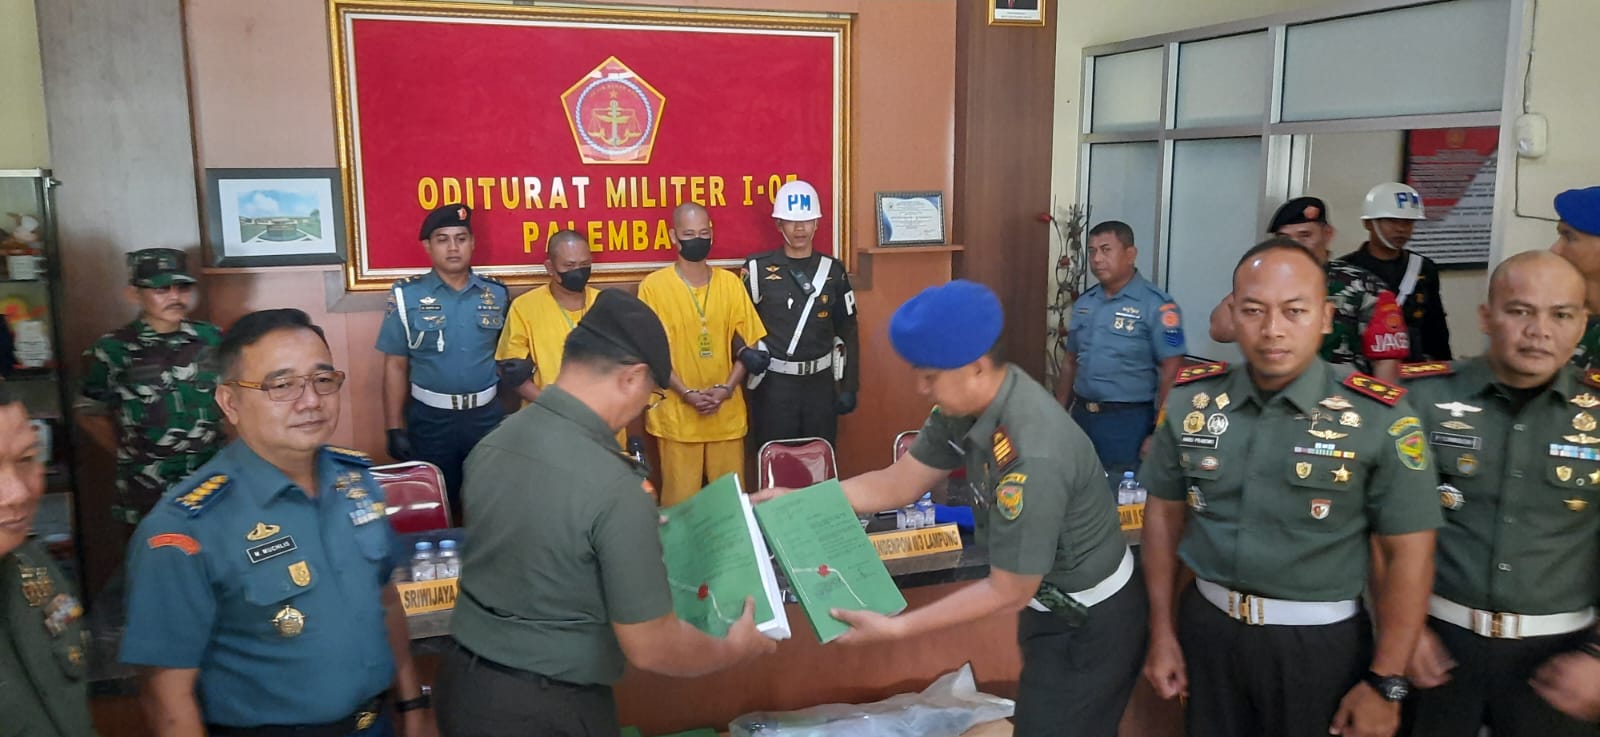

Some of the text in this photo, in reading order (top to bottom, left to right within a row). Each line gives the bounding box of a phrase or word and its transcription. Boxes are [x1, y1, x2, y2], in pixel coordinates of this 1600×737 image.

[417, 173, 798, 211] ODITURAT MILITER I-0
[787, 194, 811, 211] PM
[522, 218, 713, 254] PEMBA
[403, 585, 456, 609] SRIWIJAYA
